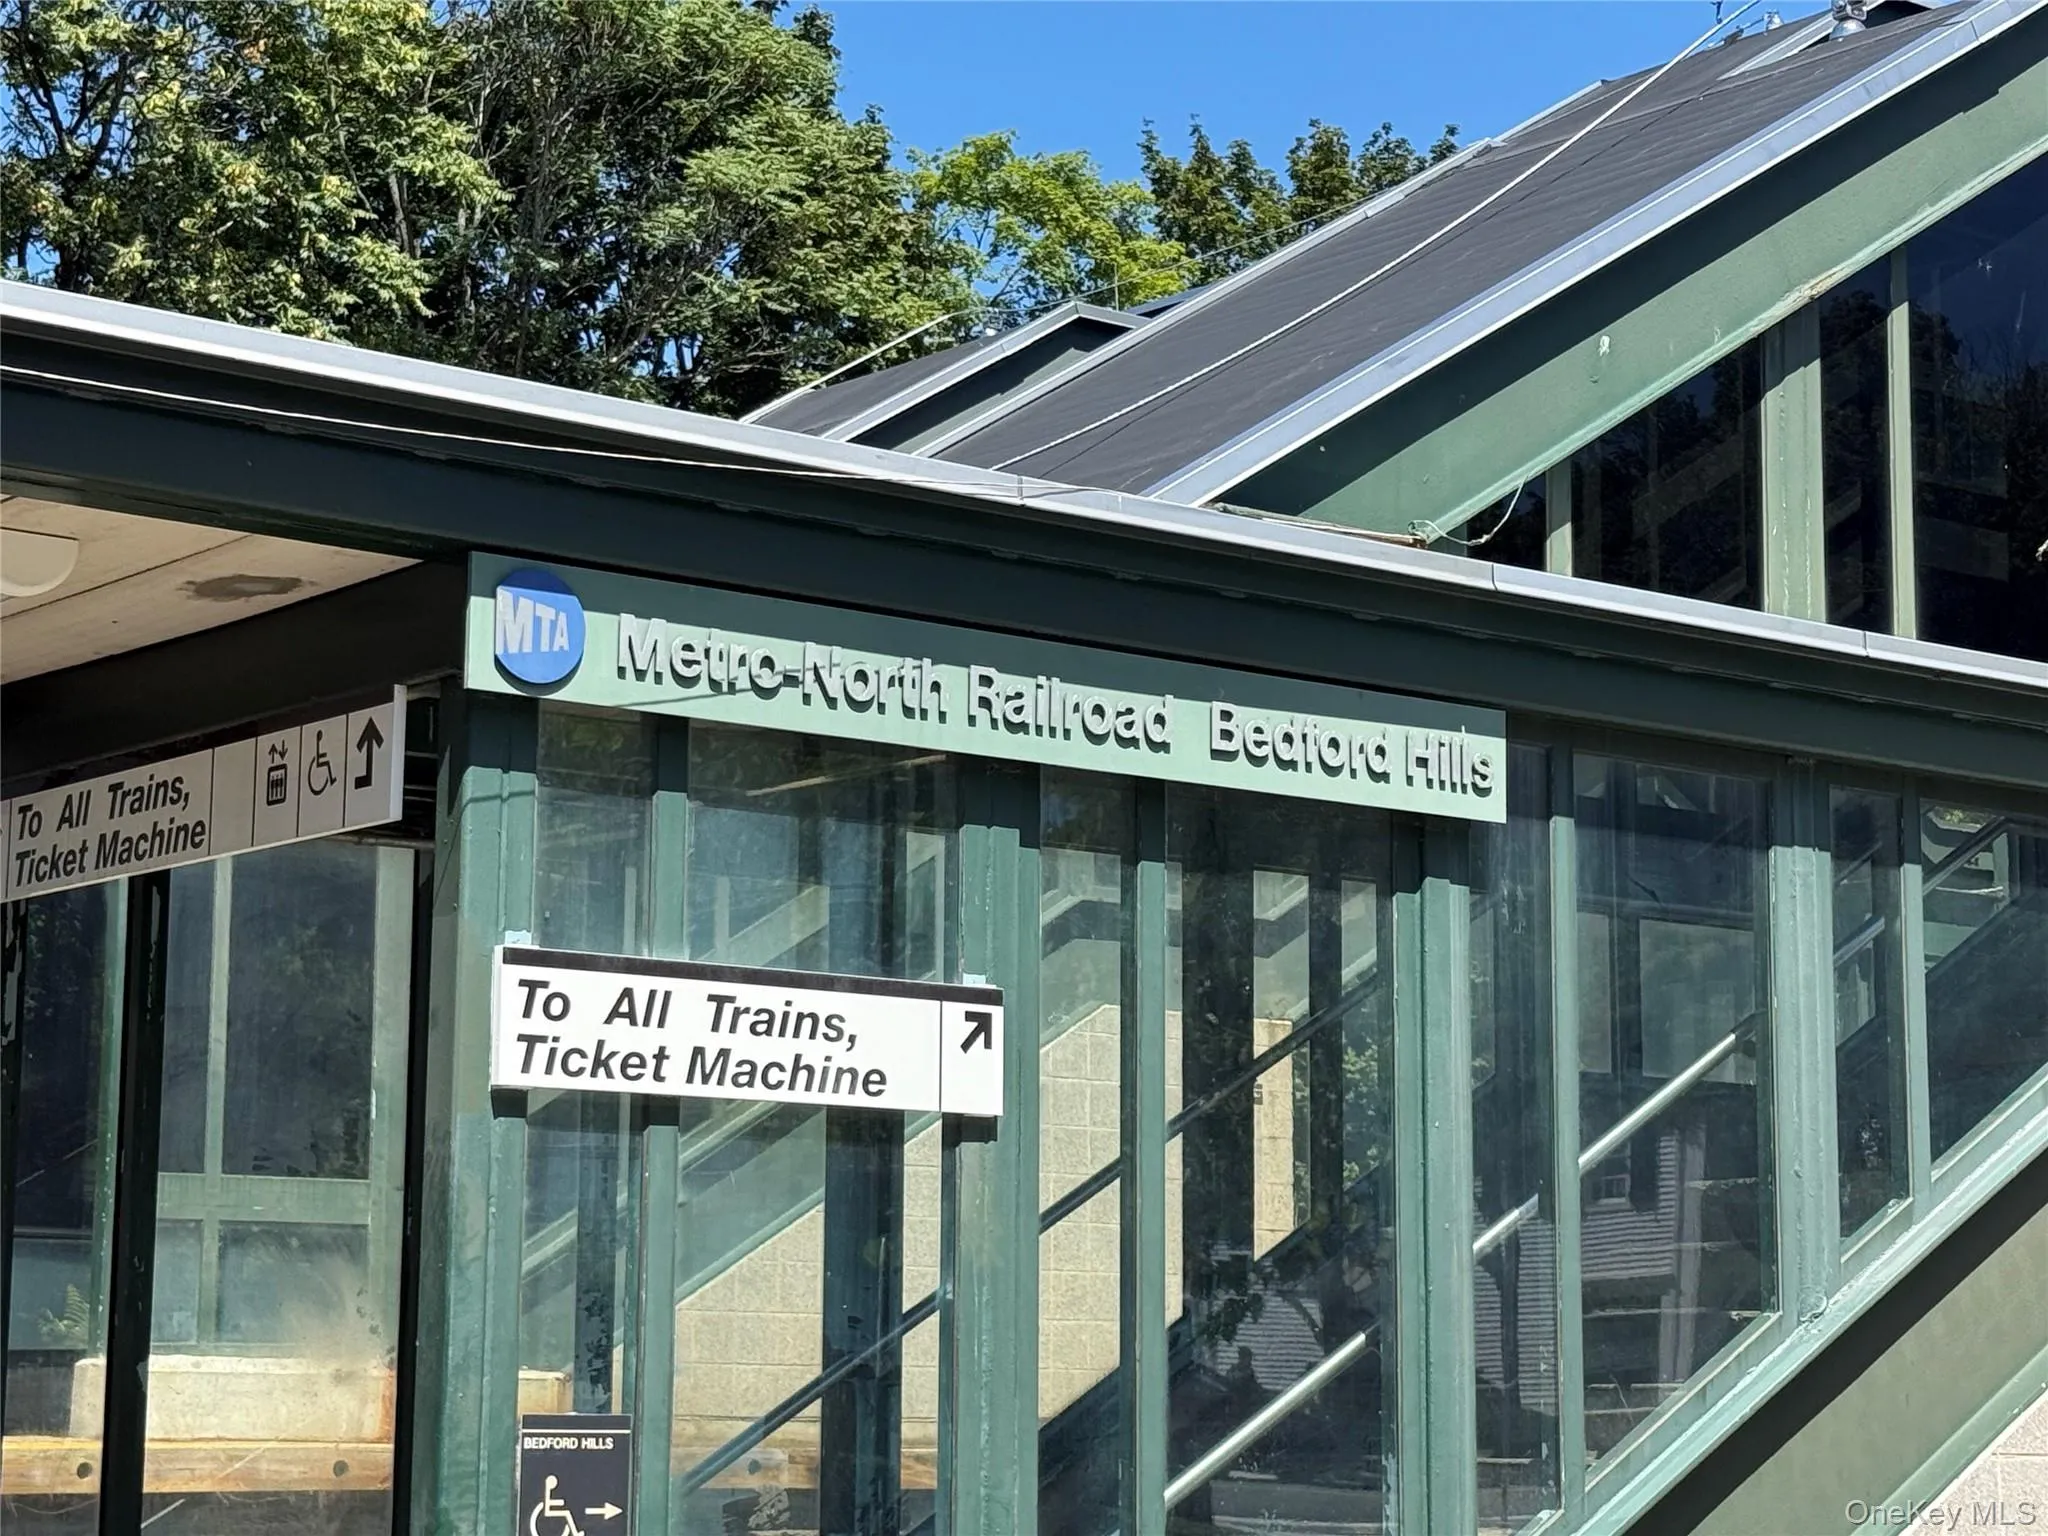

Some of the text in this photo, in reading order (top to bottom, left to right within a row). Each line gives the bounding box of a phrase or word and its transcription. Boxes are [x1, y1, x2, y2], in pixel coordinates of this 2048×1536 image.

[497, 590, 570, 655] MTA
[617, 612, 1495, 797] Metro-North Railroad Bedford Hills
[17, 774, 191, 841] To All Trains,
[15, 817, 206, 887] Ticket Machine
[517, 979, 858, 1052] To All Trains,
[515, 1034, 888, 1097] Ticket Machine
[523, 1437, 614, 1449] BEDFORD HILLS
